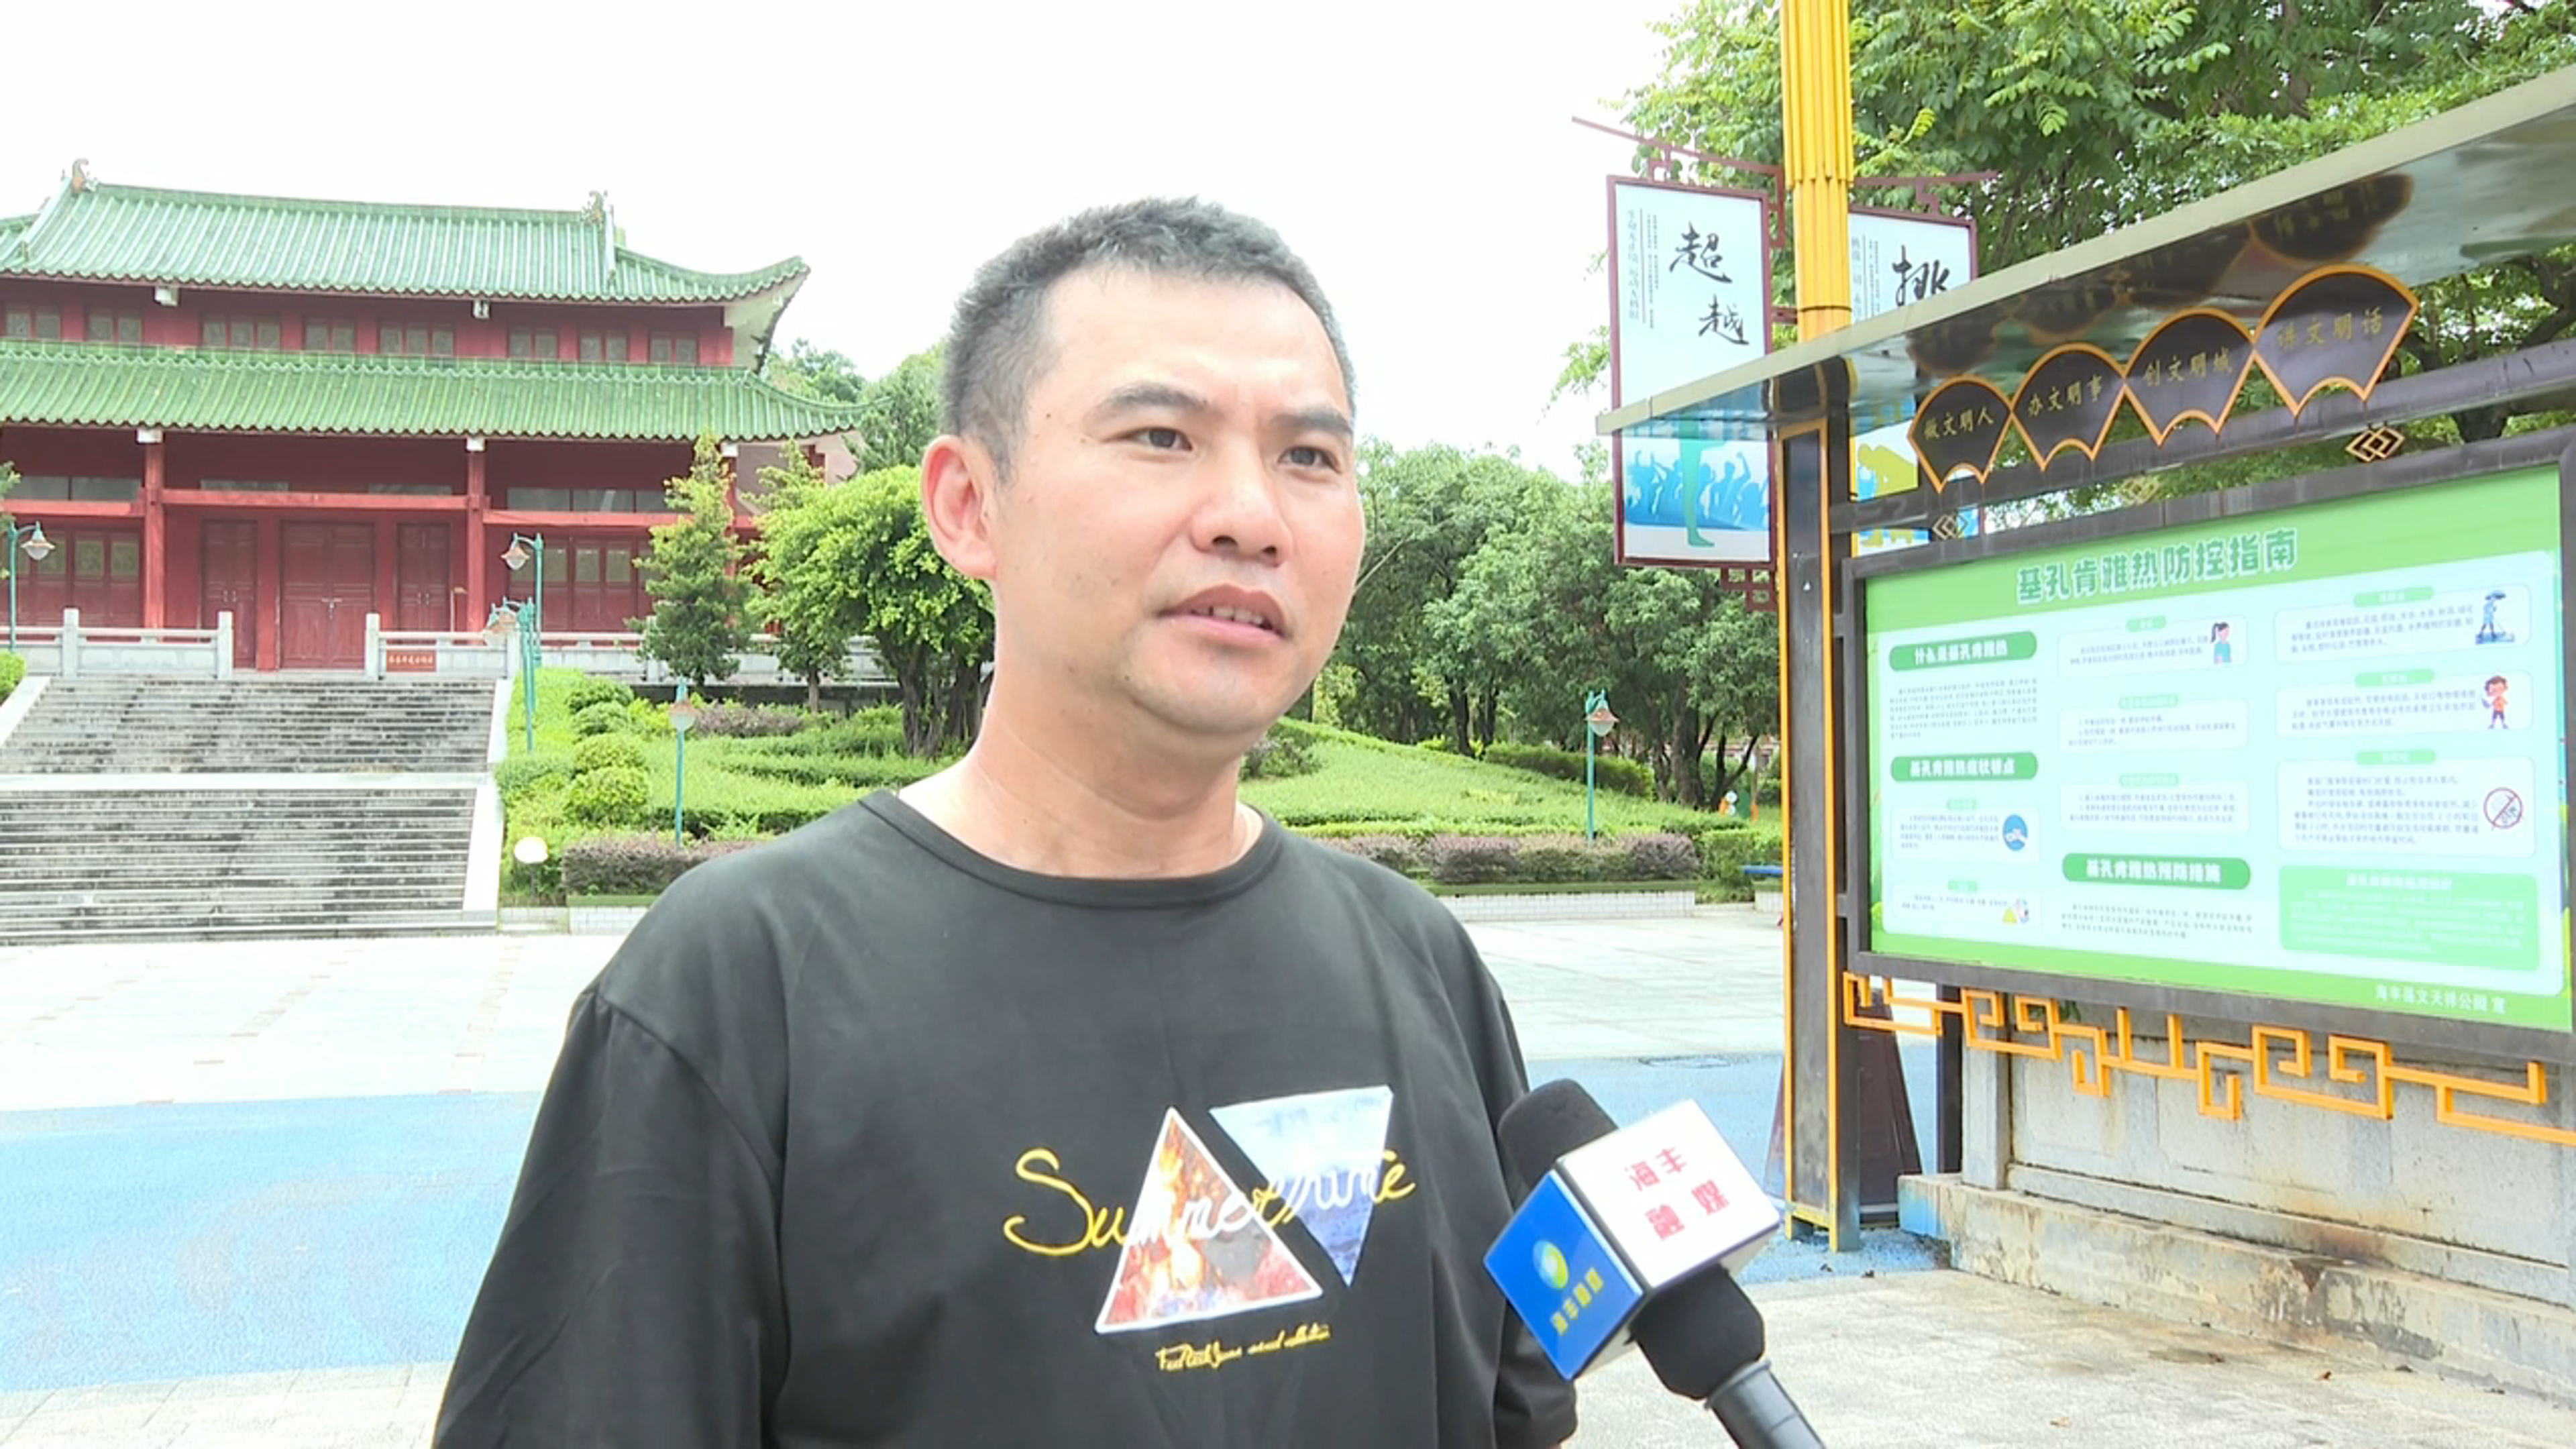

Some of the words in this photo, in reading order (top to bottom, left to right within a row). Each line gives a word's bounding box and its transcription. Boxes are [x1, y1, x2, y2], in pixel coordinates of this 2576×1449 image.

[1669, 220, 1750, 345] 超越
[2277, 306, 2383, 352] 讲文明话
[2145, 351, 2233, 388] 创文明城
[2027, 375, 2104, 417] 办文明事
[2017, 529, 2296, 603] 基孔肯雅热防控指南
[1624, 1146, 1688, 1193] 海丰
[1644, 1179, 1730, 1241] 融媒
